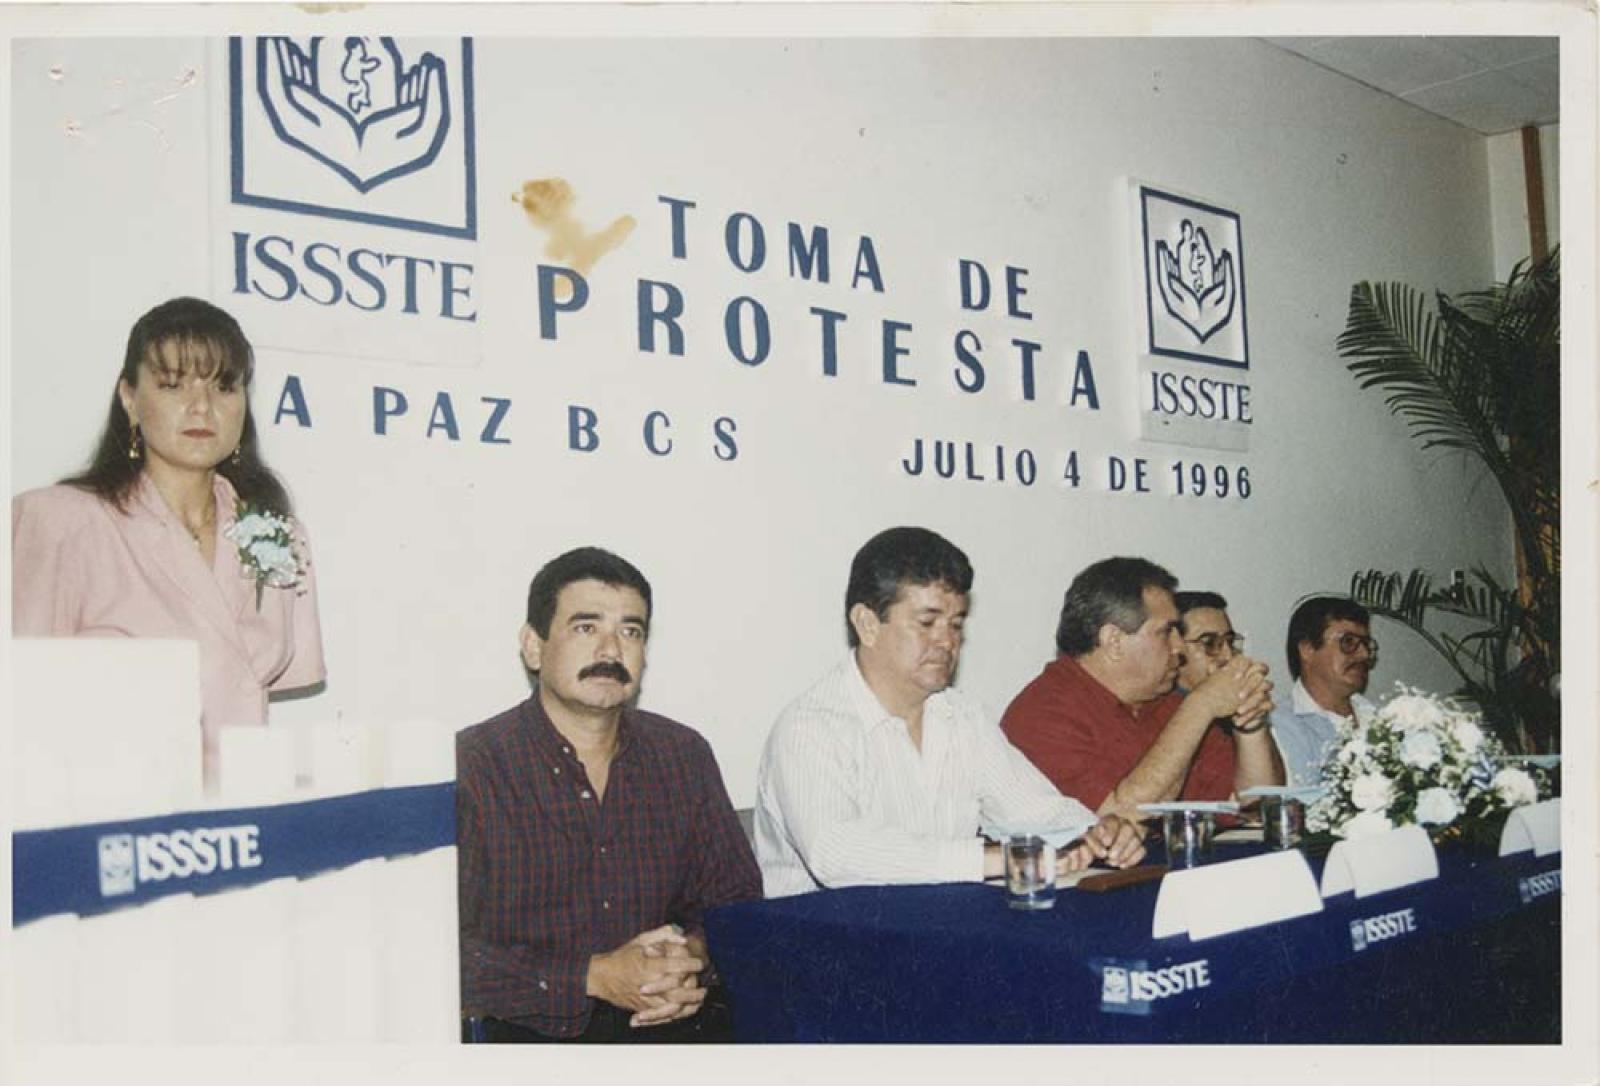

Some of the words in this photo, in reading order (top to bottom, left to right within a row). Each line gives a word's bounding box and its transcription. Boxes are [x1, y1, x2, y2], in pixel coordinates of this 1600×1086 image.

[231, 230, 477, 323] ISSSTE
[658, 194, 884, 294] TOMA
[959, 258, 1034, 321] DE
[537, 263, 1101, 411] PROTESTA
[371, 385, 513, 445] PAZ
[1151, 371, 1254, 425] ISSSTE
[902, 438, 1037, 486] JULIO
[1063, 450, 1081, 488] 4
[1109, 456, 1150, 493] DE
[1171, 460, 1251, 500] 1996
[135, 824, 262, 884] ISSSTE
[1527, 868, 1562, 897] ISSST
[1364, 907, 1417, 944] ISSSTE
[1129, 958, 1212, 1003] ISSSTE
